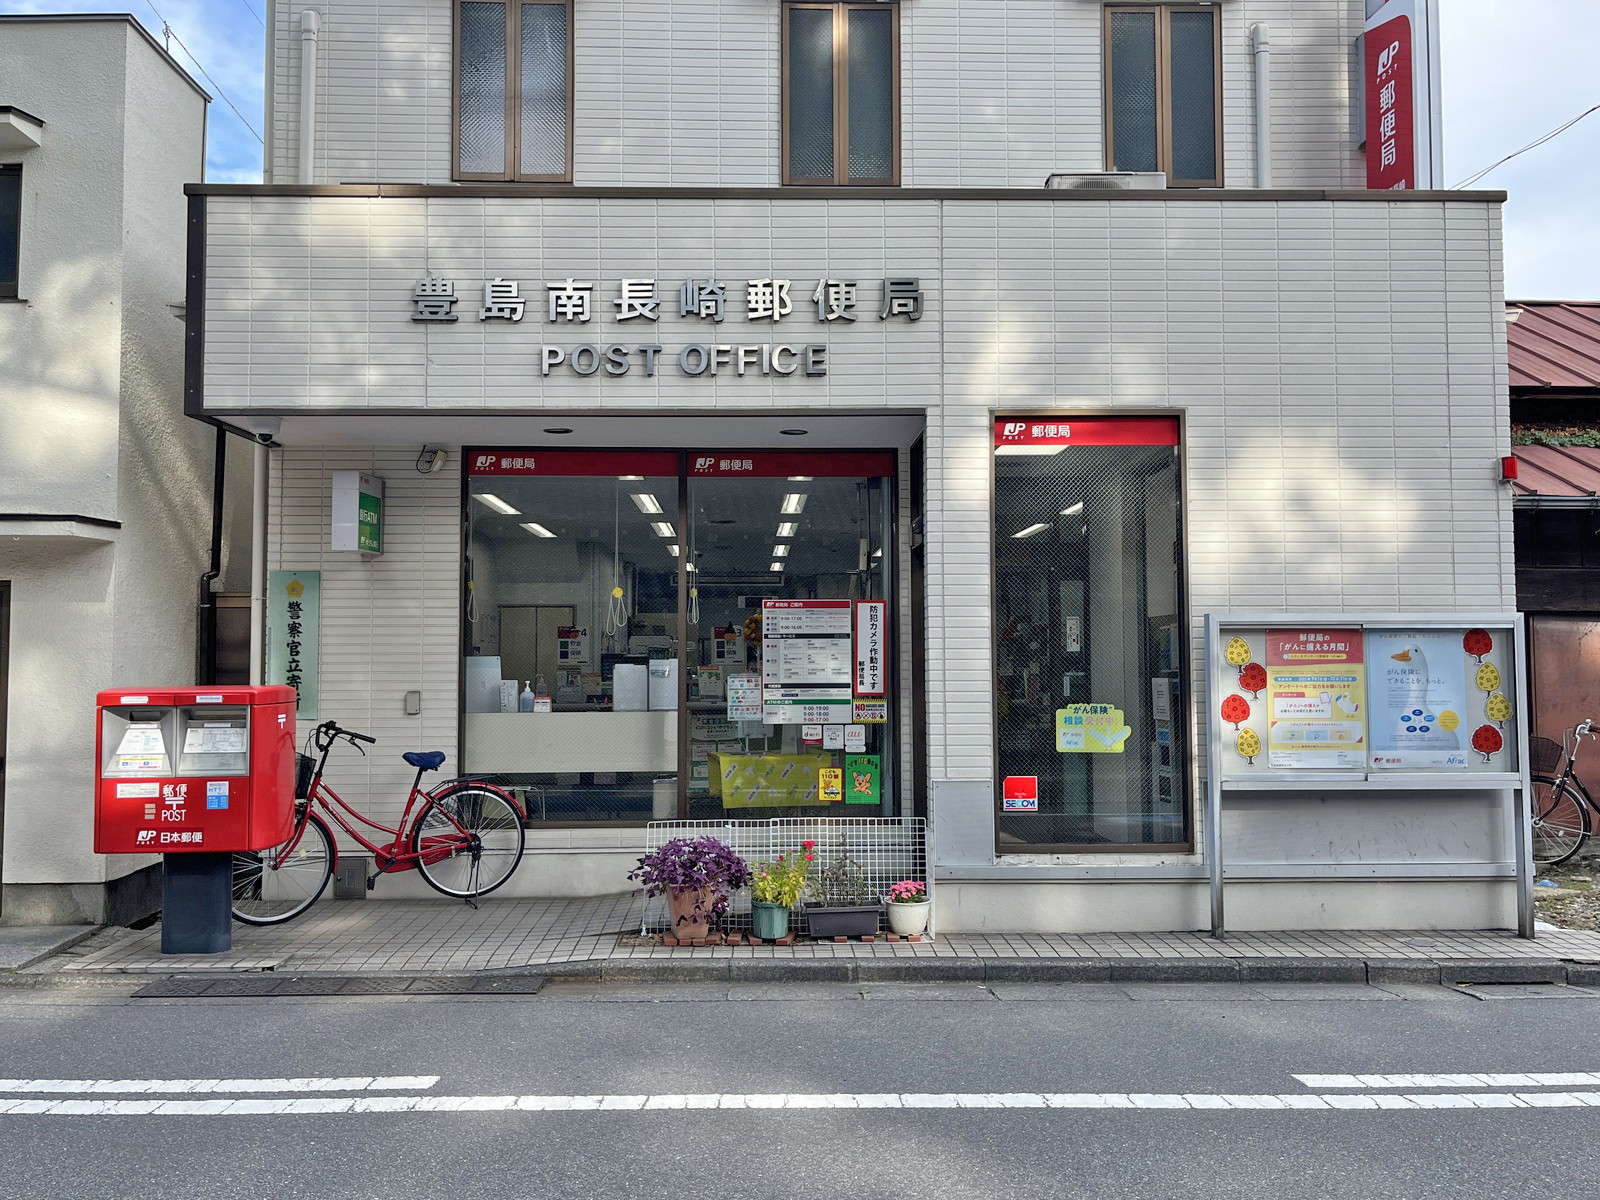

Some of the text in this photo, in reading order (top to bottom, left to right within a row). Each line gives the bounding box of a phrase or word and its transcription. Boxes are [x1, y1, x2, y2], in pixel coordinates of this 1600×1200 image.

[1376, 62, 1398, 85] POST
[1379, 79, 1396, 172] 郵便局
[411, 277, 925, 322] 豊島南長崎郵便局
[541, 343, 829, 377] POST OFFICE
[1031, 425, 1071, 438] 郵便局
[501, 457, 535, 469] 郵便局
[719, 459, 753, 471] 郵便局
[581, 628, 587, 637] 4
[736, 629, 742, 637] 3
[869, 605, 879, 690] 防犯カメラ作動中です
[1279, 643, 1350, 651] 「がんに備える月間」
[855, 703, 865, 712] NO
[1073, 706, 1109, 715] がん保険
[162, 784, 188, 798] 郵便
[161, 810, 186, 822] POST
[160, 832, 203, 843] 日本郵便
